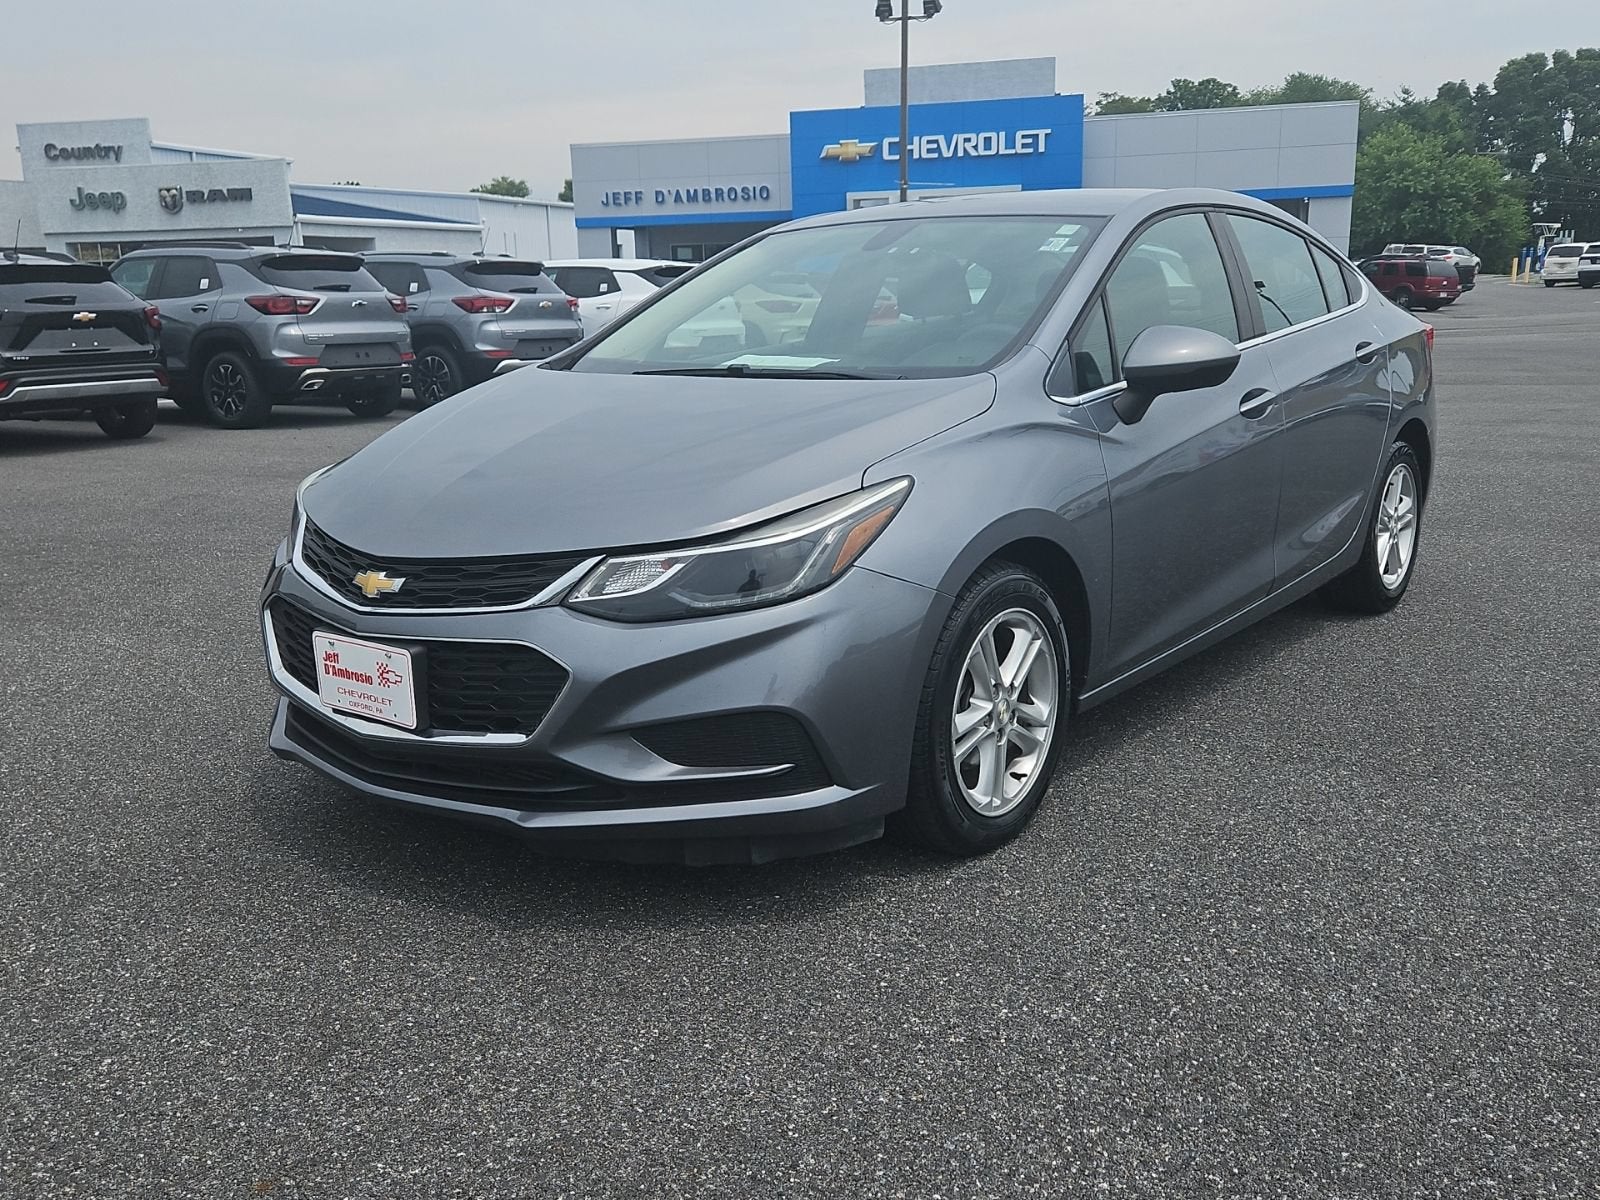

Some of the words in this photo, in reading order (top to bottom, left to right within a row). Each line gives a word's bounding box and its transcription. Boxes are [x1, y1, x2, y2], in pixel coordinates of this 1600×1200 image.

[44, 143, 123, 162] Country
[882, 129, 1052, 161] CHEVROLET
[69, 186, 127, 213] Jeep
[186, 187, 252, 203] RAM
[602, 190, 643, 207] JEFF
[654, 185, 770, 204] D'AMBROSIO
[323, 650, 340, 664] Jeff
[324, 663, 373, 686] D'Ambrosio
[337, 686, 393, 706] CHEVROLET
